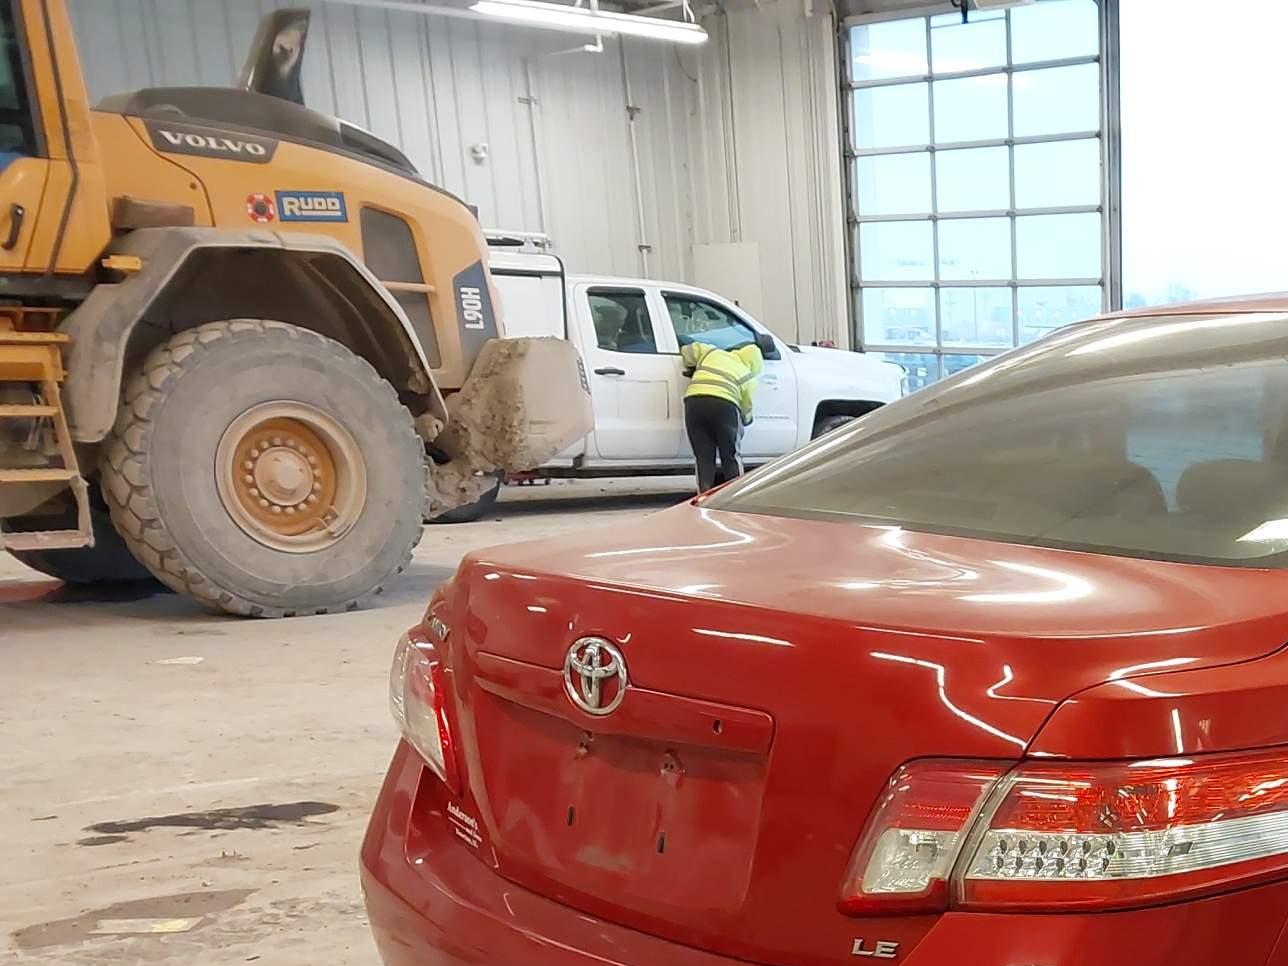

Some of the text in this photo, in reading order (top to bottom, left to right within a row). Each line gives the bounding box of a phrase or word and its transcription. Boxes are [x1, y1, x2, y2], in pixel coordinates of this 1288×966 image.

[159, 130, 266, 156] VOLVO
[282, 196, 341, 216] RUDD
[460, 286, 485, 330] L90H
[851, 938, 900, 959] LE
